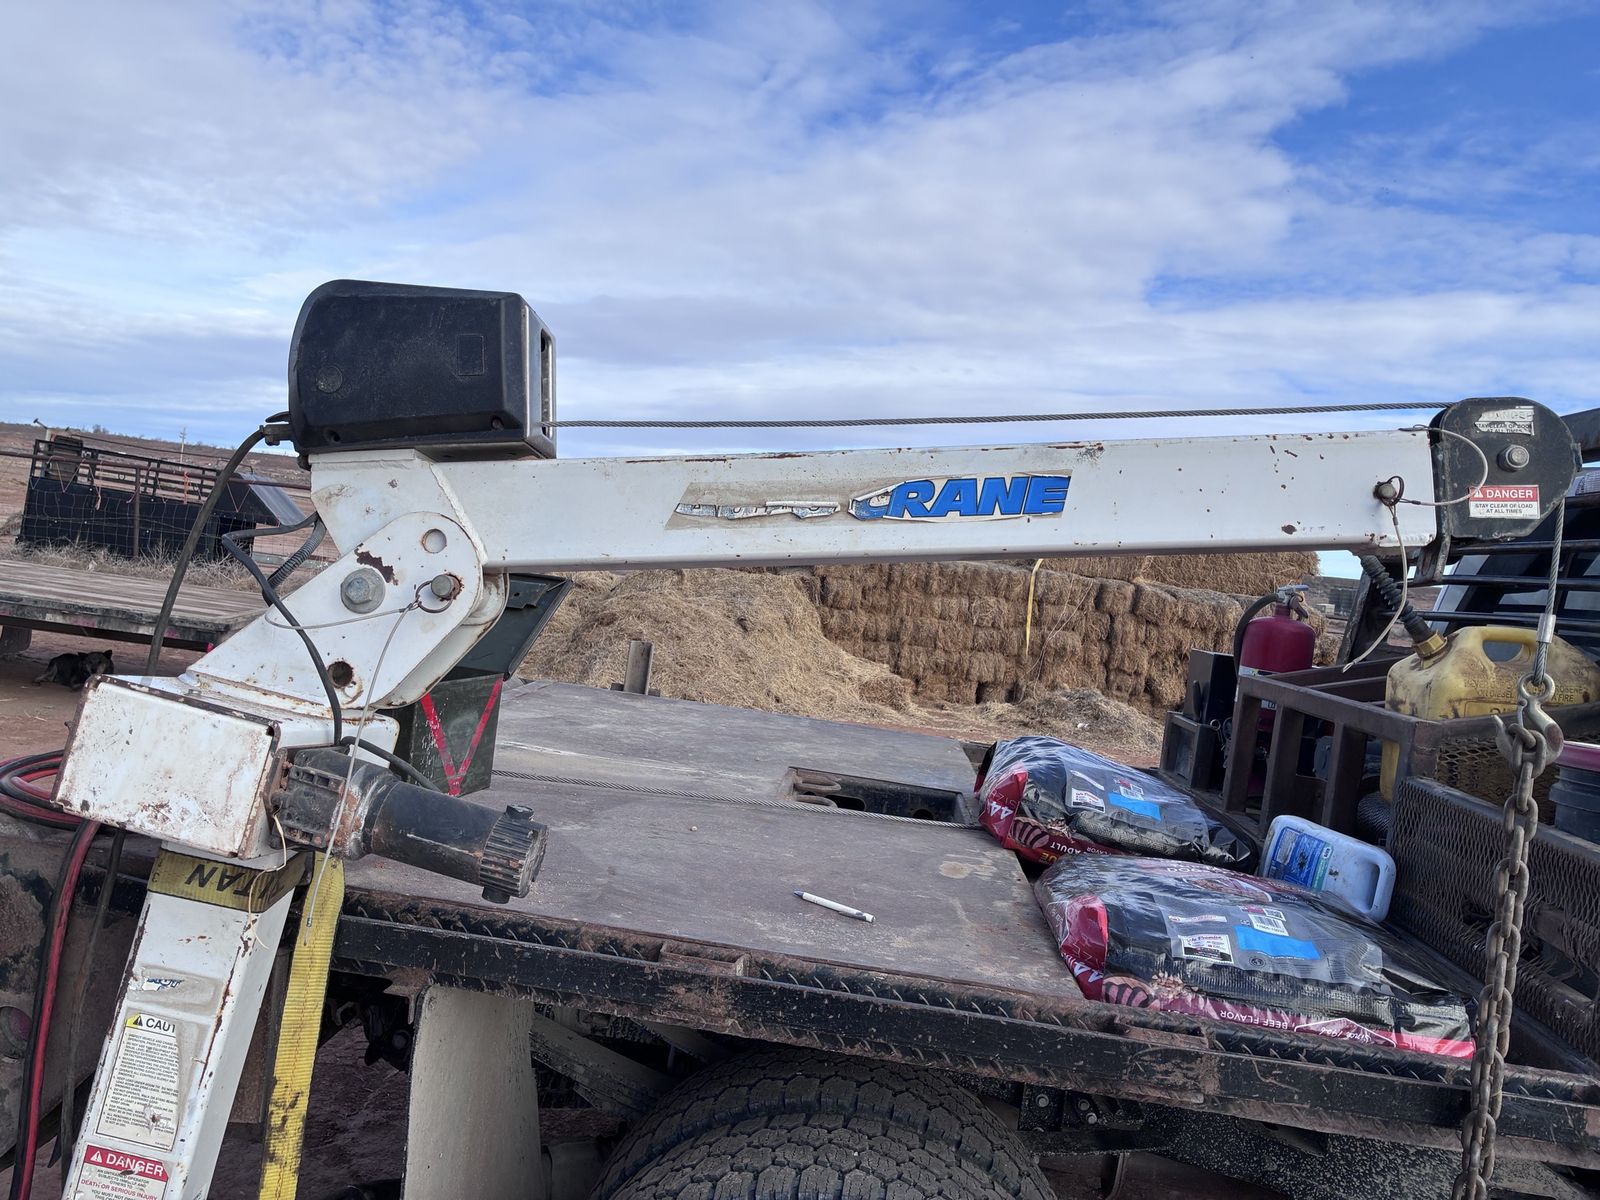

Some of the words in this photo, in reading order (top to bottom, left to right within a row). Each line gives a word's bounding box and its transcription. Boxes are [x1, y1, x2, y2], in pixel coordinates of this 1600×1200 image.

[1486, 489, 1534, 498] DANGER
[990, 801, 1014, 820] 44
[1050, 842, 1081, 854] ADULT
[1219, 1009, 1259, 1024] FLAVOR
[1262, 1018, 1287, 1028] BEEF
[106, 1153, 164, 1178] DANGER
[111, 1186, 135, 1196] SERIOUS
